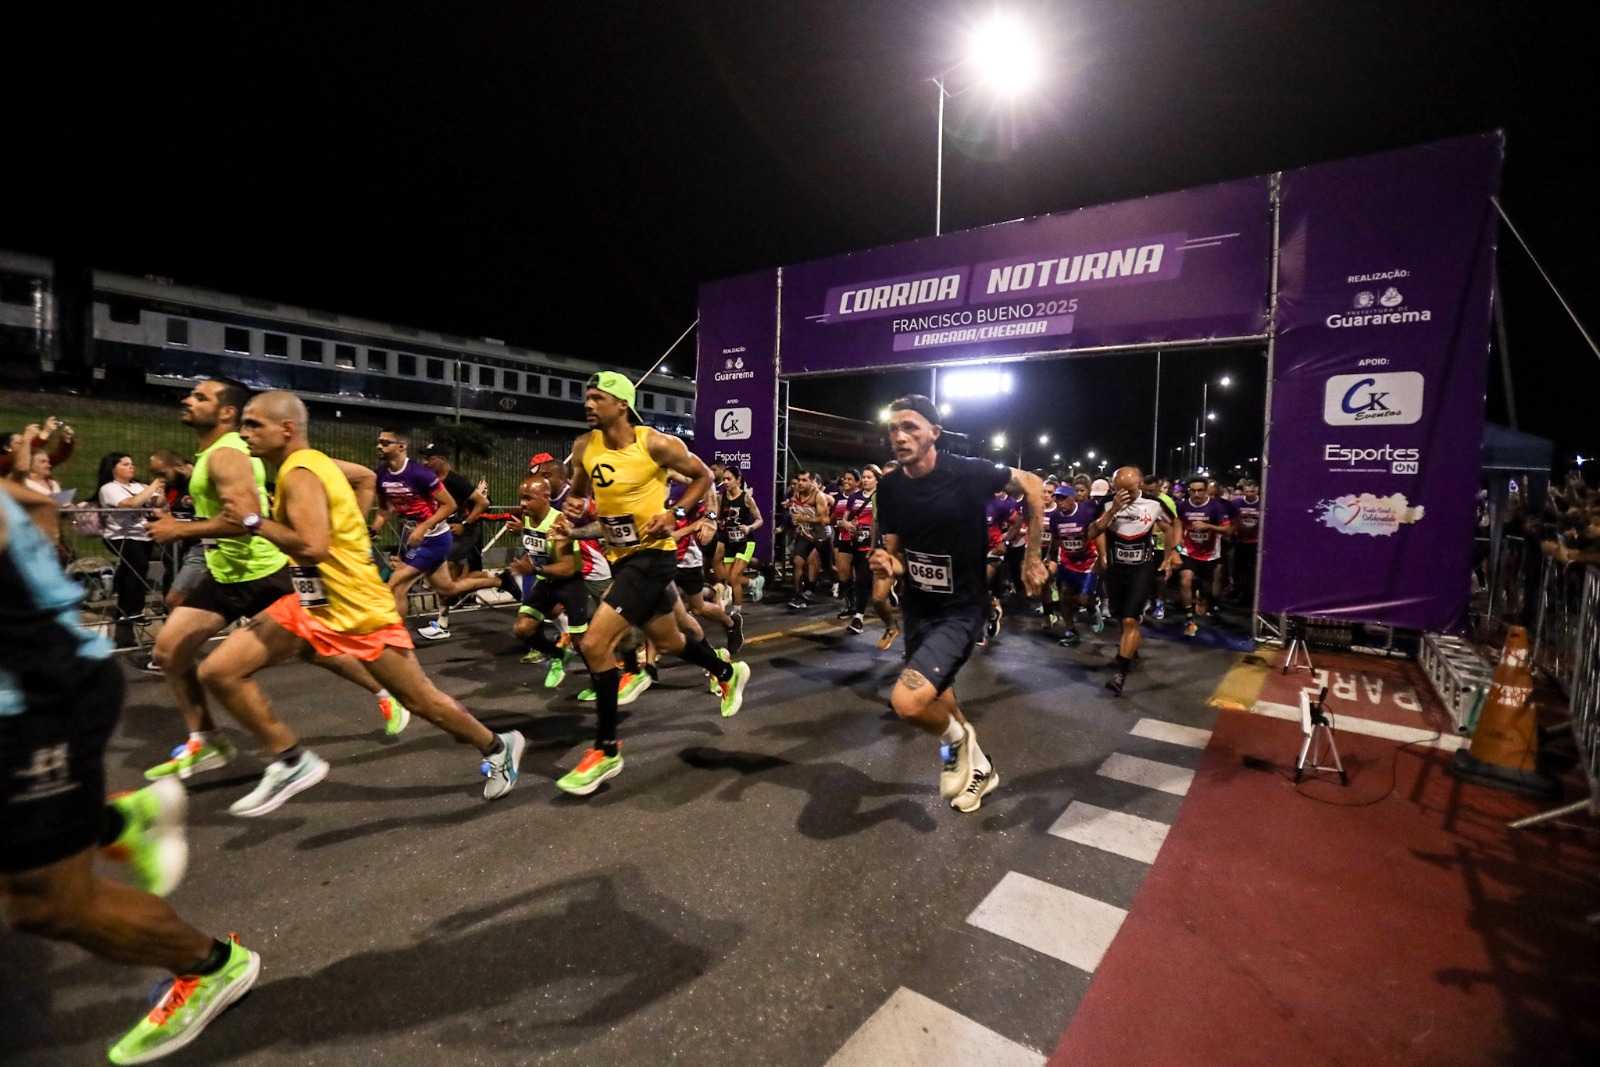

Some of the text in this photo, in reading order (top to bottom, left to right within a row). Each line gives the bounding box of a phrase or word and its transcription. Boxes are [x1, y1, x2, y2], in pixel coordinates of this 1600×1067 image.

[839, 243, 1165, 315] CORRIDA NOTURNA
[1348, 269, 1410, 284] REALIZAÇÃO:
[893, 299, 1079, 333] FRANCISCO BUENO 2025
[1326, 309, 1431, 329] Guararema
[914, 320, 1048, 347] LARGADA/CHEGADA
[1358, 357, 1390, 367] APOIO:
[715, 370, 754, 382] Guararema
[1341, 378, 1391, 415] CK
[720, 411, 740, 433] CK
[1354, 410, 1403, 421] Eventos
[1325, 443, 1420, 466] Esportes
[525, 537, 543, 549] 0331
[1118, 550, 1140, 559] 0987
[910, 564, 945, 580] 0686
